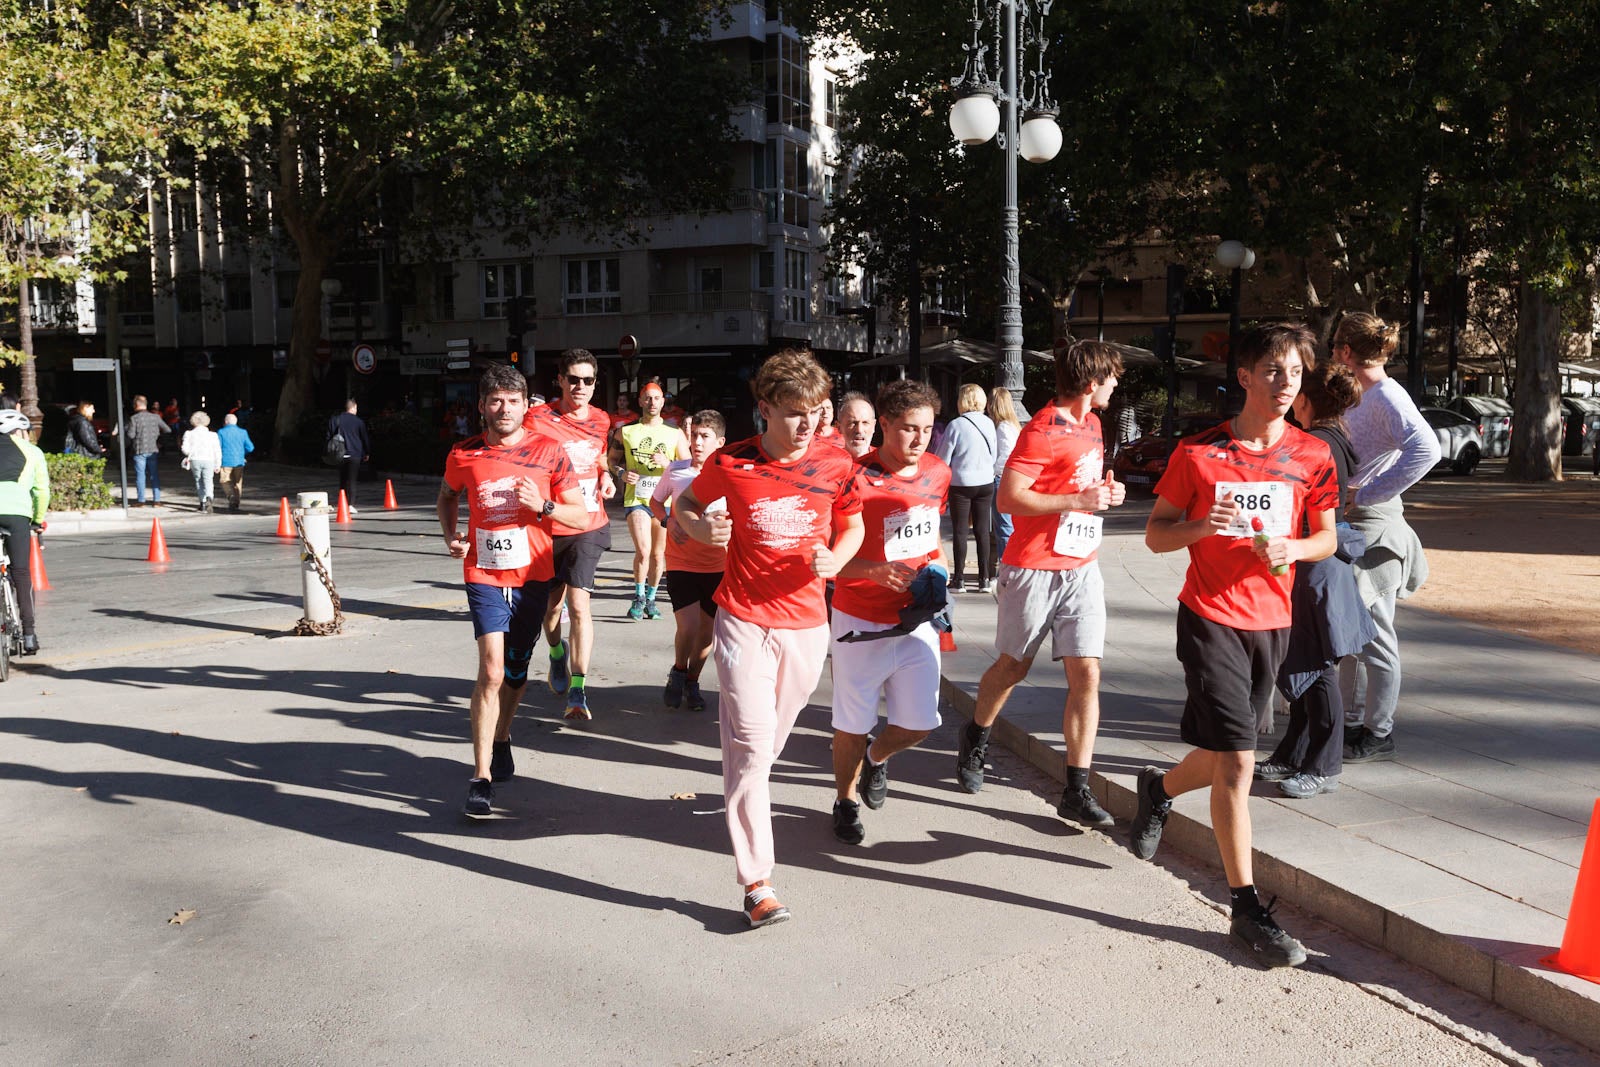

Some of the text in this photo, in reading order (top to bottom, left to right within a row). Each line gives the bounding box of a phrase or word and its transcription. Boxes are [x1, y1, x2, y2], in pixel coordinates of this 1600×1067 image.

[416, 358, 449, 369] FARMAC
[1233, 494, 1271, 511] 886
[895, 521, 932, 540] 1613
[1067, 522, 1095, 539] 1115
[486, 539, 513, 551] 643
